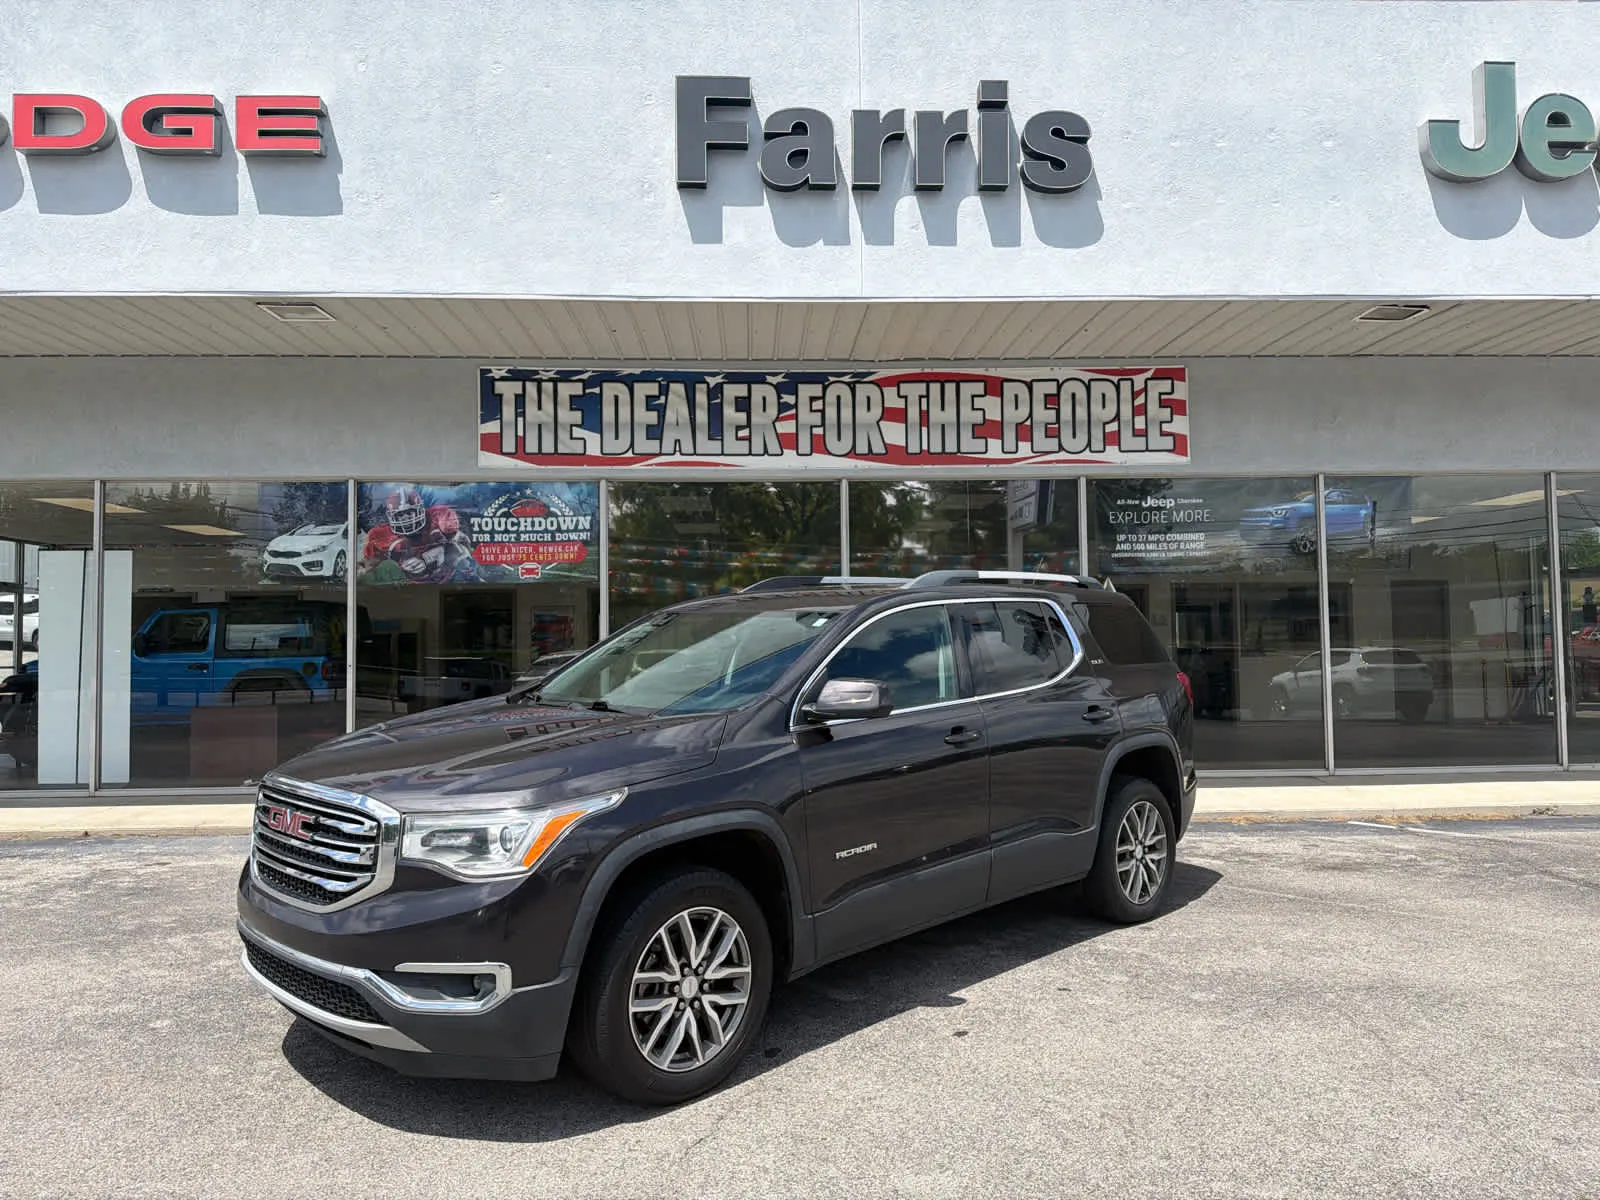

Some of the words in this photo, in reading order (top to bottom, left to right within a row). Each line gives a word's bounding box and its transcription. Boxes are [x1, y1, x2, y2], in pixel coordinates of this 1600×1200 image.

[0, 93, 328, 156] DGE
[1417, 61, 1600, 183] Je
[675, 75, 1092, 193] Farris
[493, 379, 587, 456] THE
[600, 379, 784, 456] DEALER
[796, 379, 887, 456] FOR
[897, 379, 988, 455] THE
[1001, 377, 1176, 454] PEOPLE
[1141, 496, 1175, 509] Jeep
[470, 516, 592, 531] TOUCHDOWN
[1109, 510, 1168, 524] EXPLORE
[472, 534, 490, 542] FOR
[494, 533, 517, 542] NOT
[520, 533, 552, 542] MUCH
[555, 532, 591, 541] DOWN!
[1116, 534, 1127, 542] UP
[1128, 534, 1137, 542] TO
[1148, 533, 1165, 541] MPG
[1115, 543, 1132, 551] AND
[1132, 543, 1144, 551] 500
[1169, 542, 1179, 550] OF
[498, 553, 515, 561] JUST
[530, 553, 552, 561] CENTS
[267, 806, 313, 839] GMC
[835, 842, 878, 860] ACADIA
